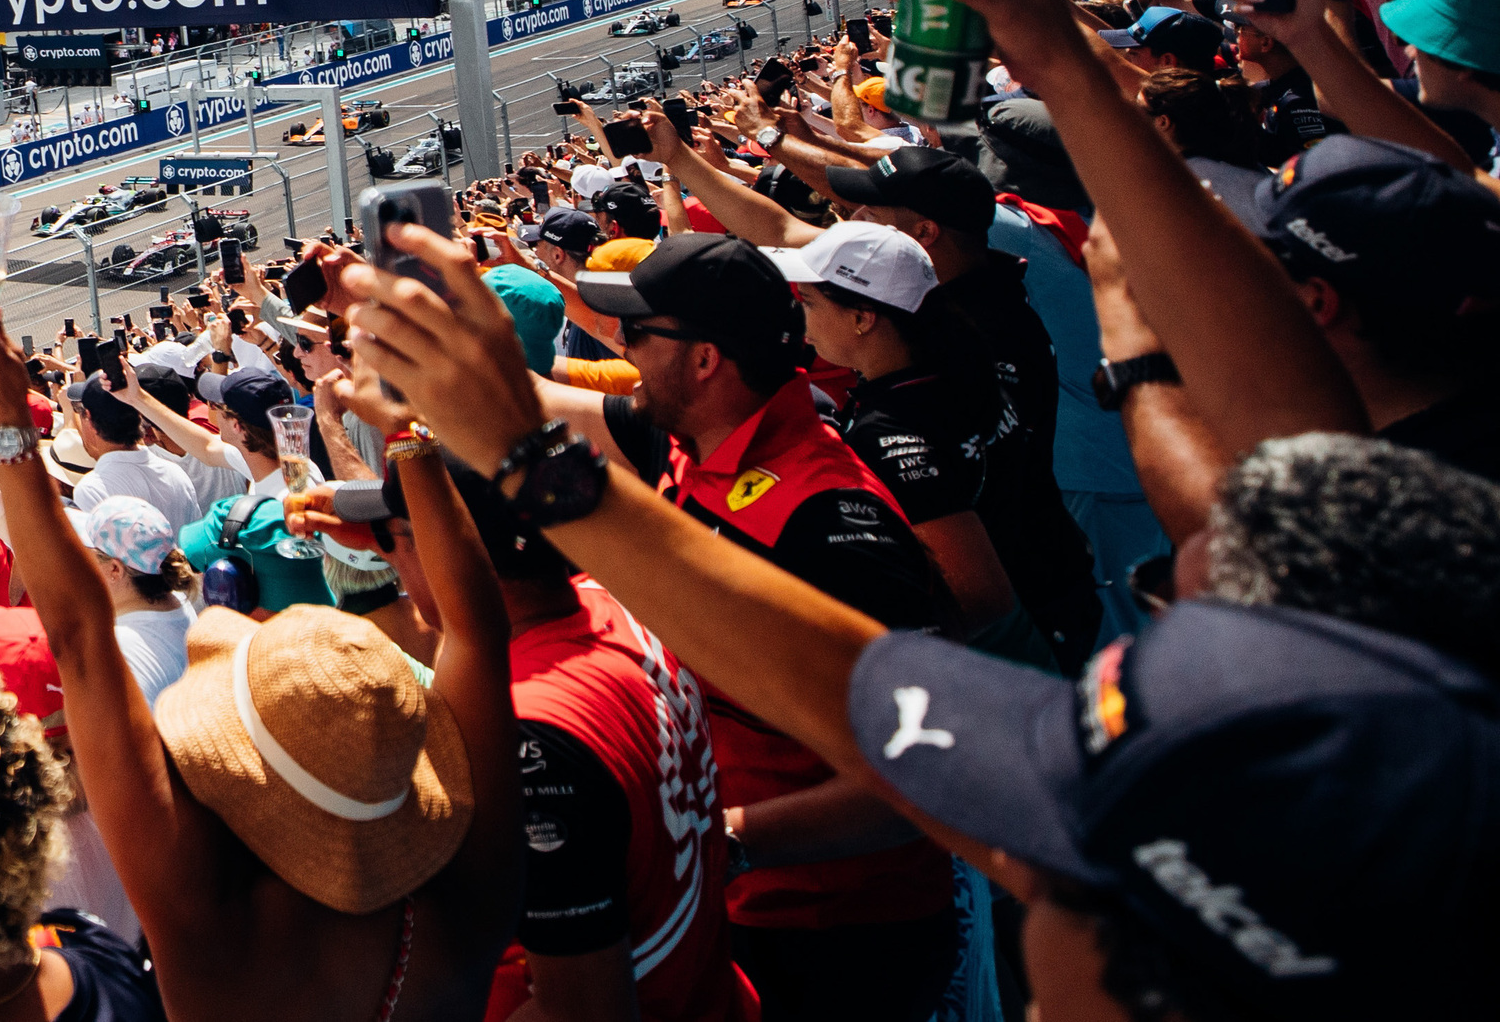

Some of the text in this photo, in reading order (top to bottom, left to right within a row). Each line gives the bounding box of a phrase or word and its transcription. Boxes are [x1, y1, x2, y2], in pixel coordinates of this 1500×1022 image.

[515, 4, 569, 33] crypto.com
[39, 46, 101, 61] crypto.com
[317, 52, 392, 89] crypto.com
[1293, 114, 1326, 125] citrix
[29, 121, 139, 169] crypto.com
[177, 165, 245, 180] crypto.com
[878, 434, 926, 448] EPSON
[899, 455, 927, 469] IWC
[838, 500, 878, 519] aws
